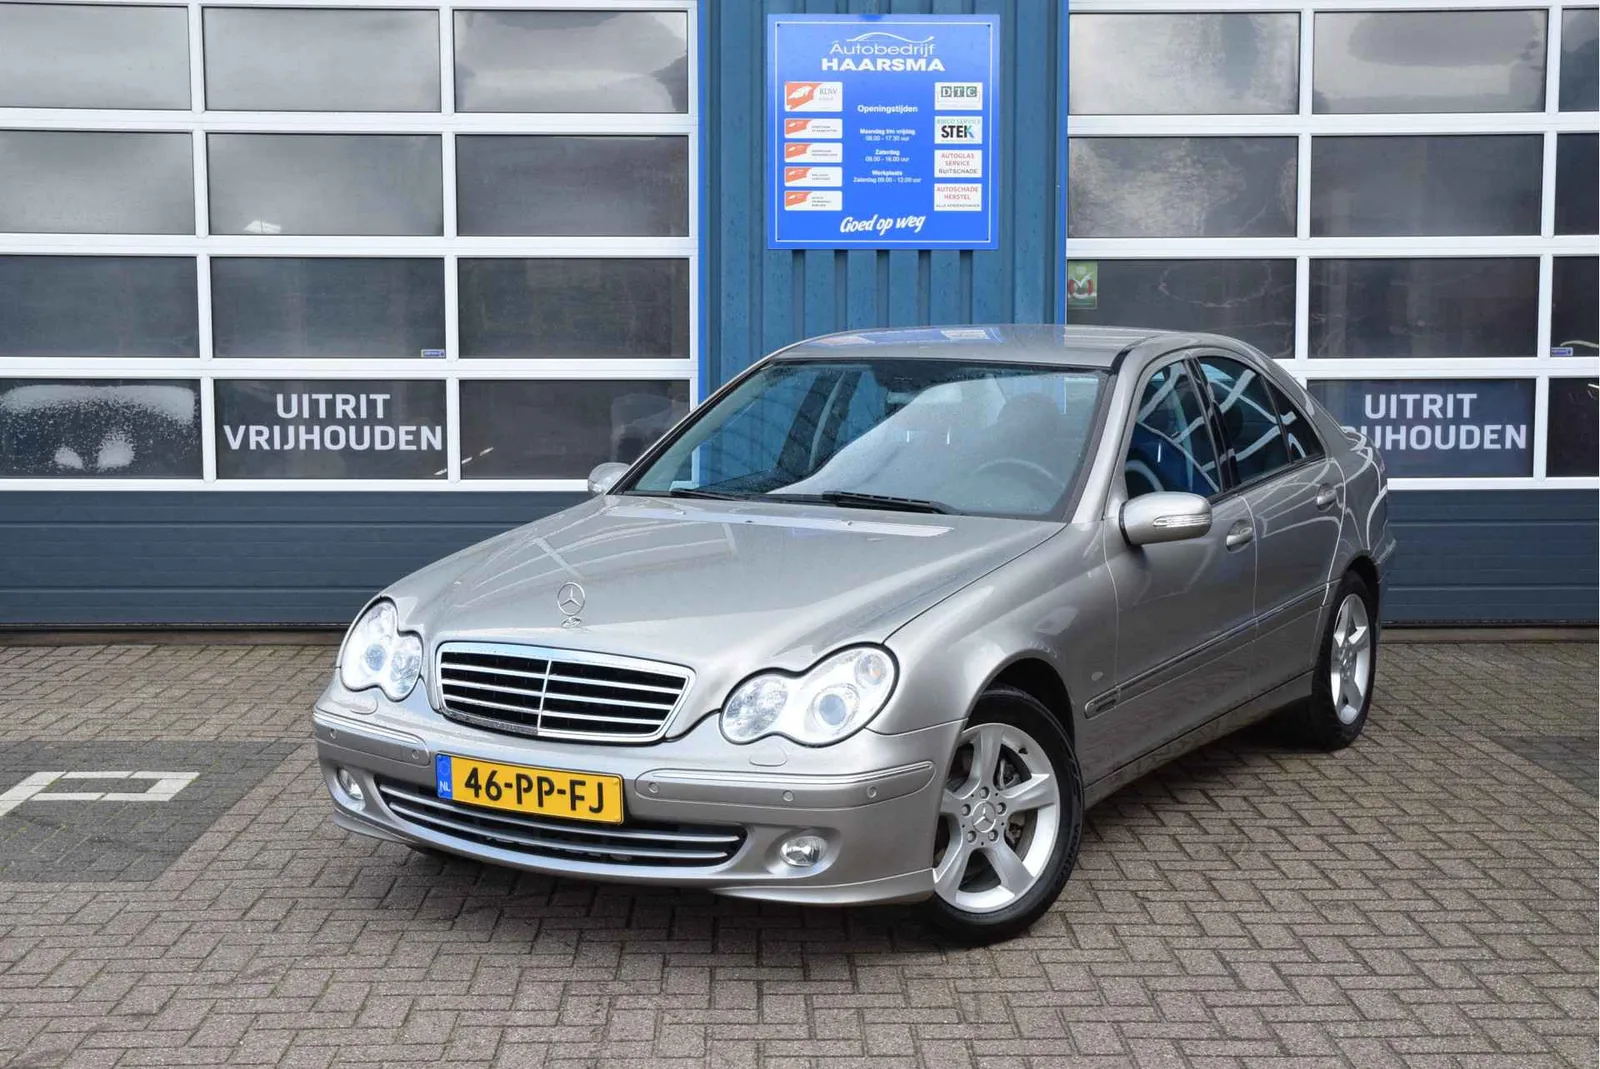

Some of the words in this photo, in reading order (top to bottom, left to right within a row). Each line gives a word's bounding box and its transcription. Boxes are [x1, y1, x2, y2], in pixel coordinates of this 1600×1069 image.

[830, 43, 936, 57] Autobedrijf
[821, 58, 946, 71] HAARSMA
[941, 86, 977, 97] DTC
[857, 105, 918, 114] Openingstijden
[941, 125, 975, 138] STEK
[840, 214, 878, 233] Goed
[876, 218, 893, 236] op
[895, 215, 926, 233] weg
[276, 394, 390, 419] UITRIT
[1365, 393, 1477, 419] UITRIT
[223, 425, 443, 451] VRIJHOUDEN
[439, 780, 451, 793] NL
[464, 767, 604, 814] 46-PP-FJ
